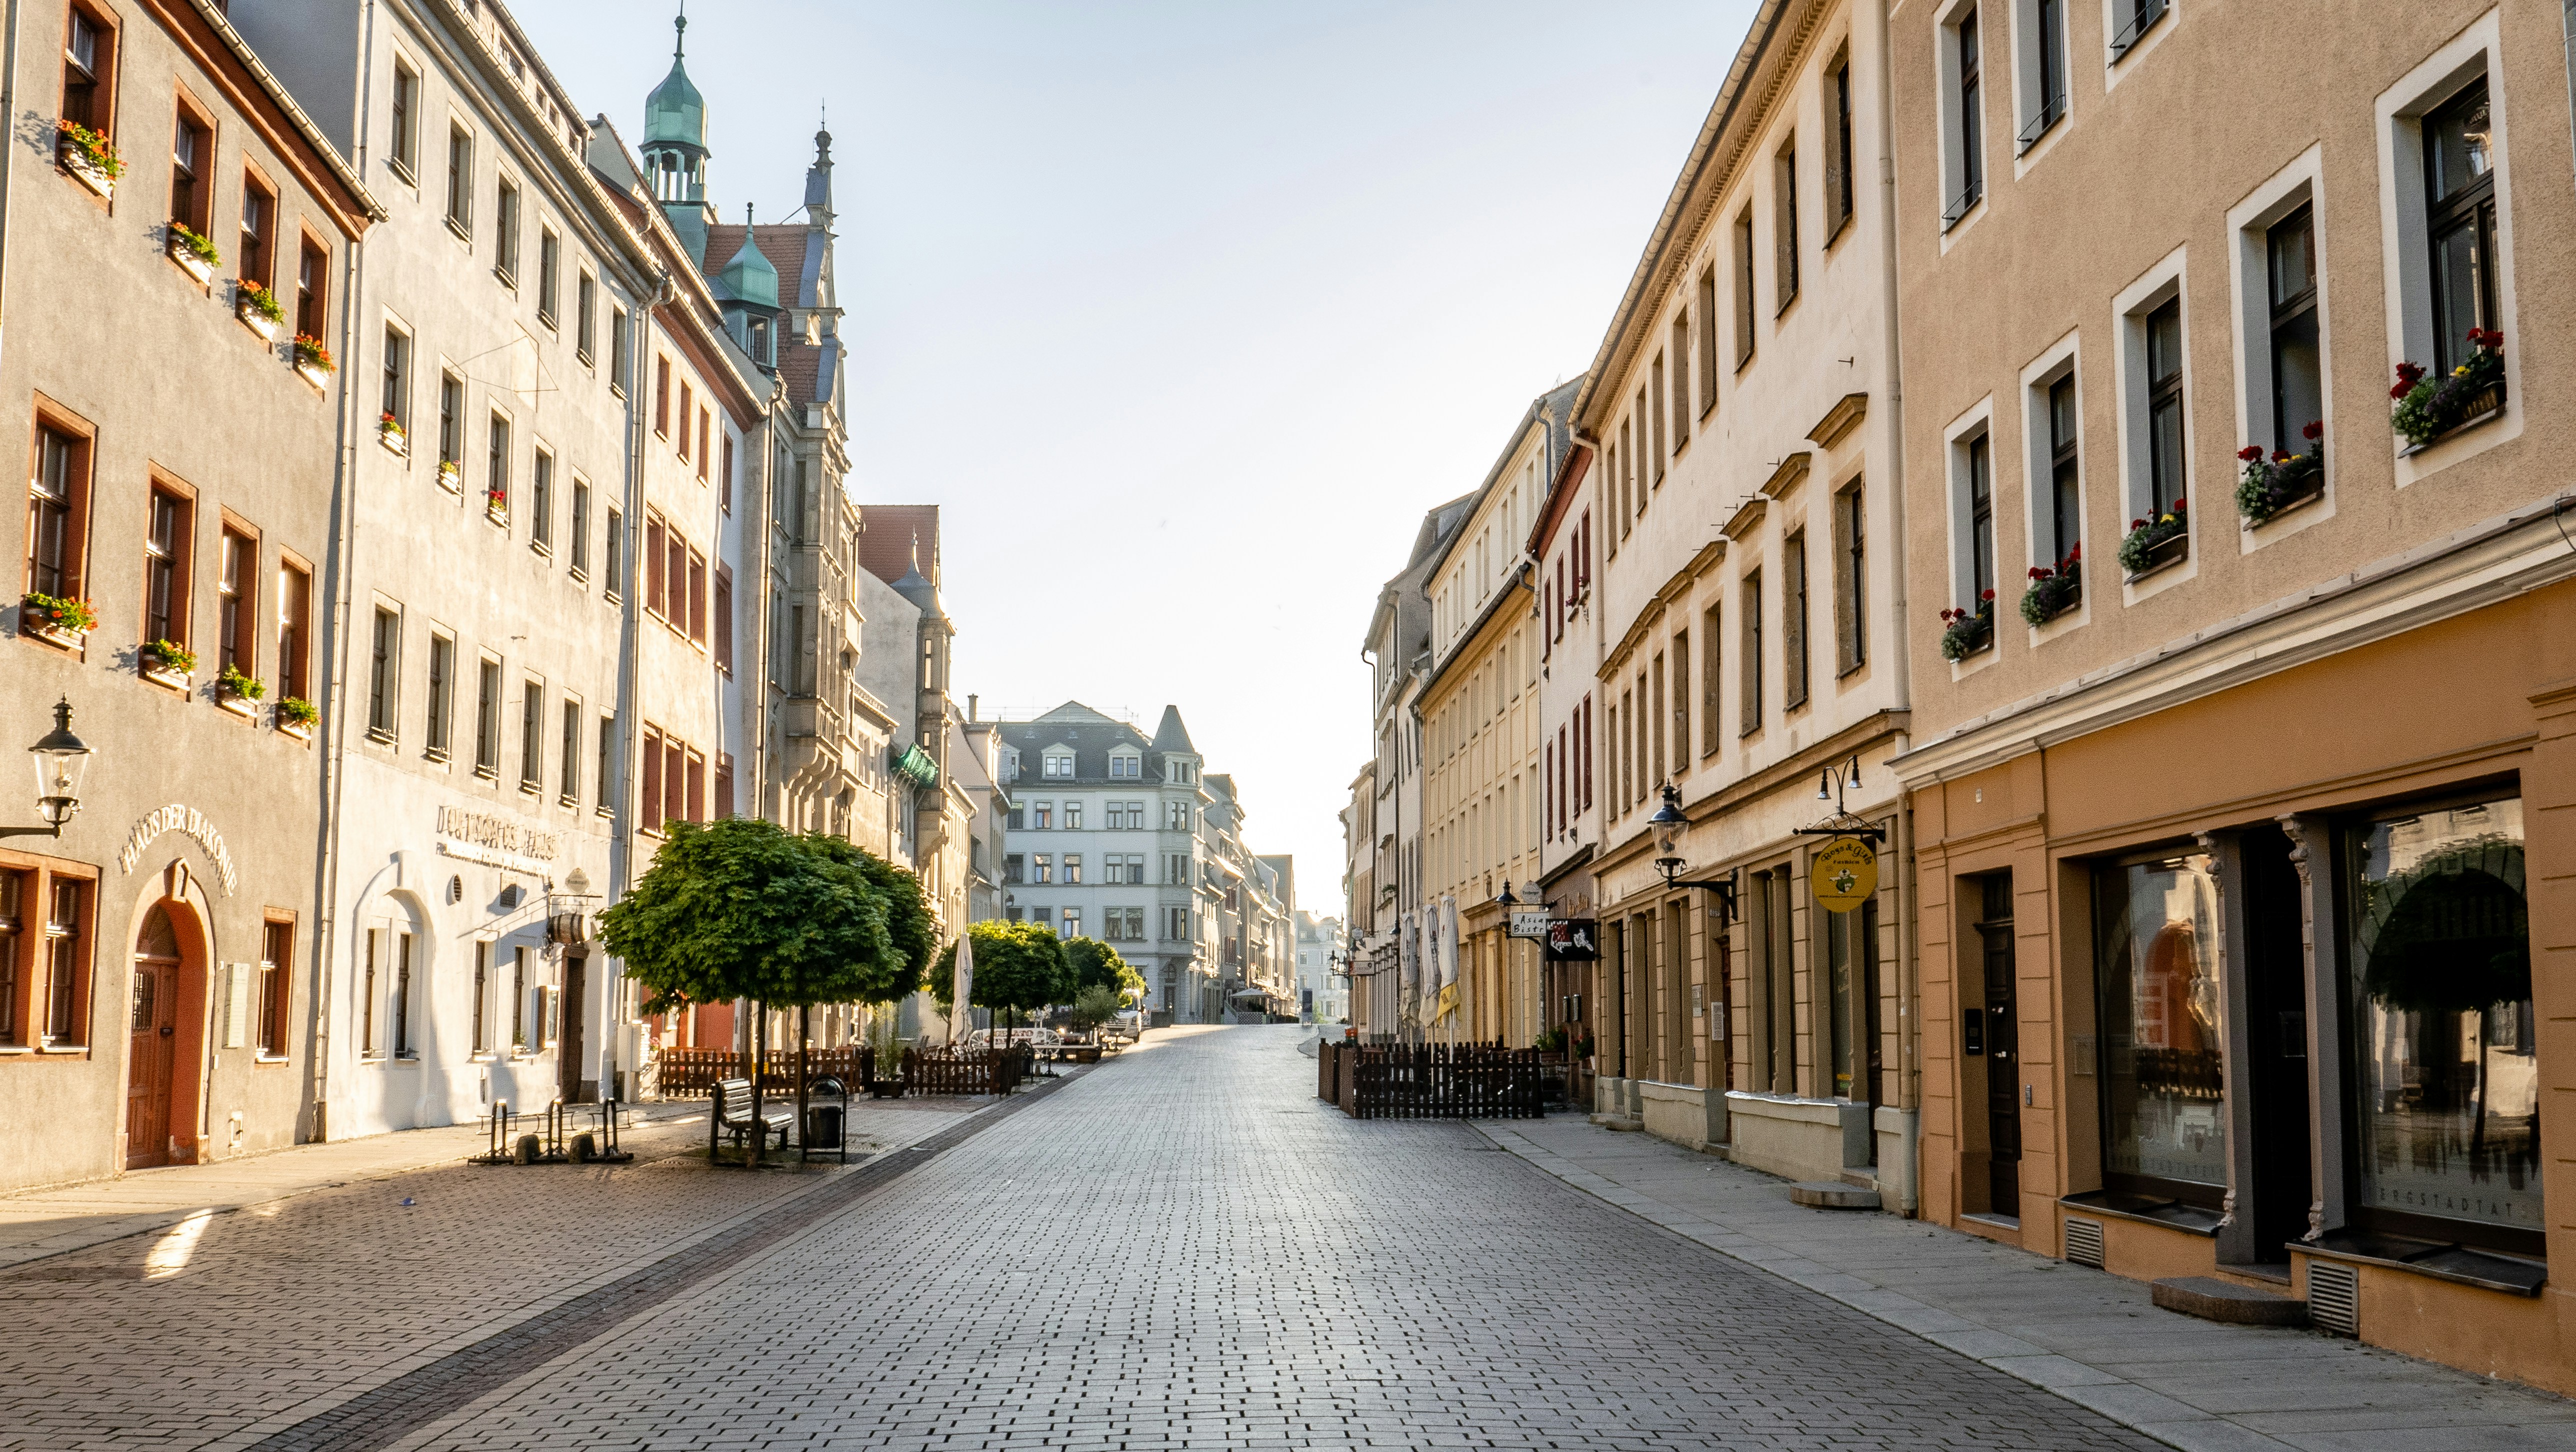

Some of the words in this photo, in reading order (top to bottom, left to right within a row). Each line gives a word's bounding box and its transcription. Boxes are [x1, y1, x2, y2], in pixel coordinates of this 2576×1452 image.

[124, 810, 160, 876] HAUS
[160, 804, 186, 833] DER
[186, 807, 238, 897] DIAKONIE
[1520, 915, 1544, 924] Asia
[1514, 924, 1544, 934] Bistr
